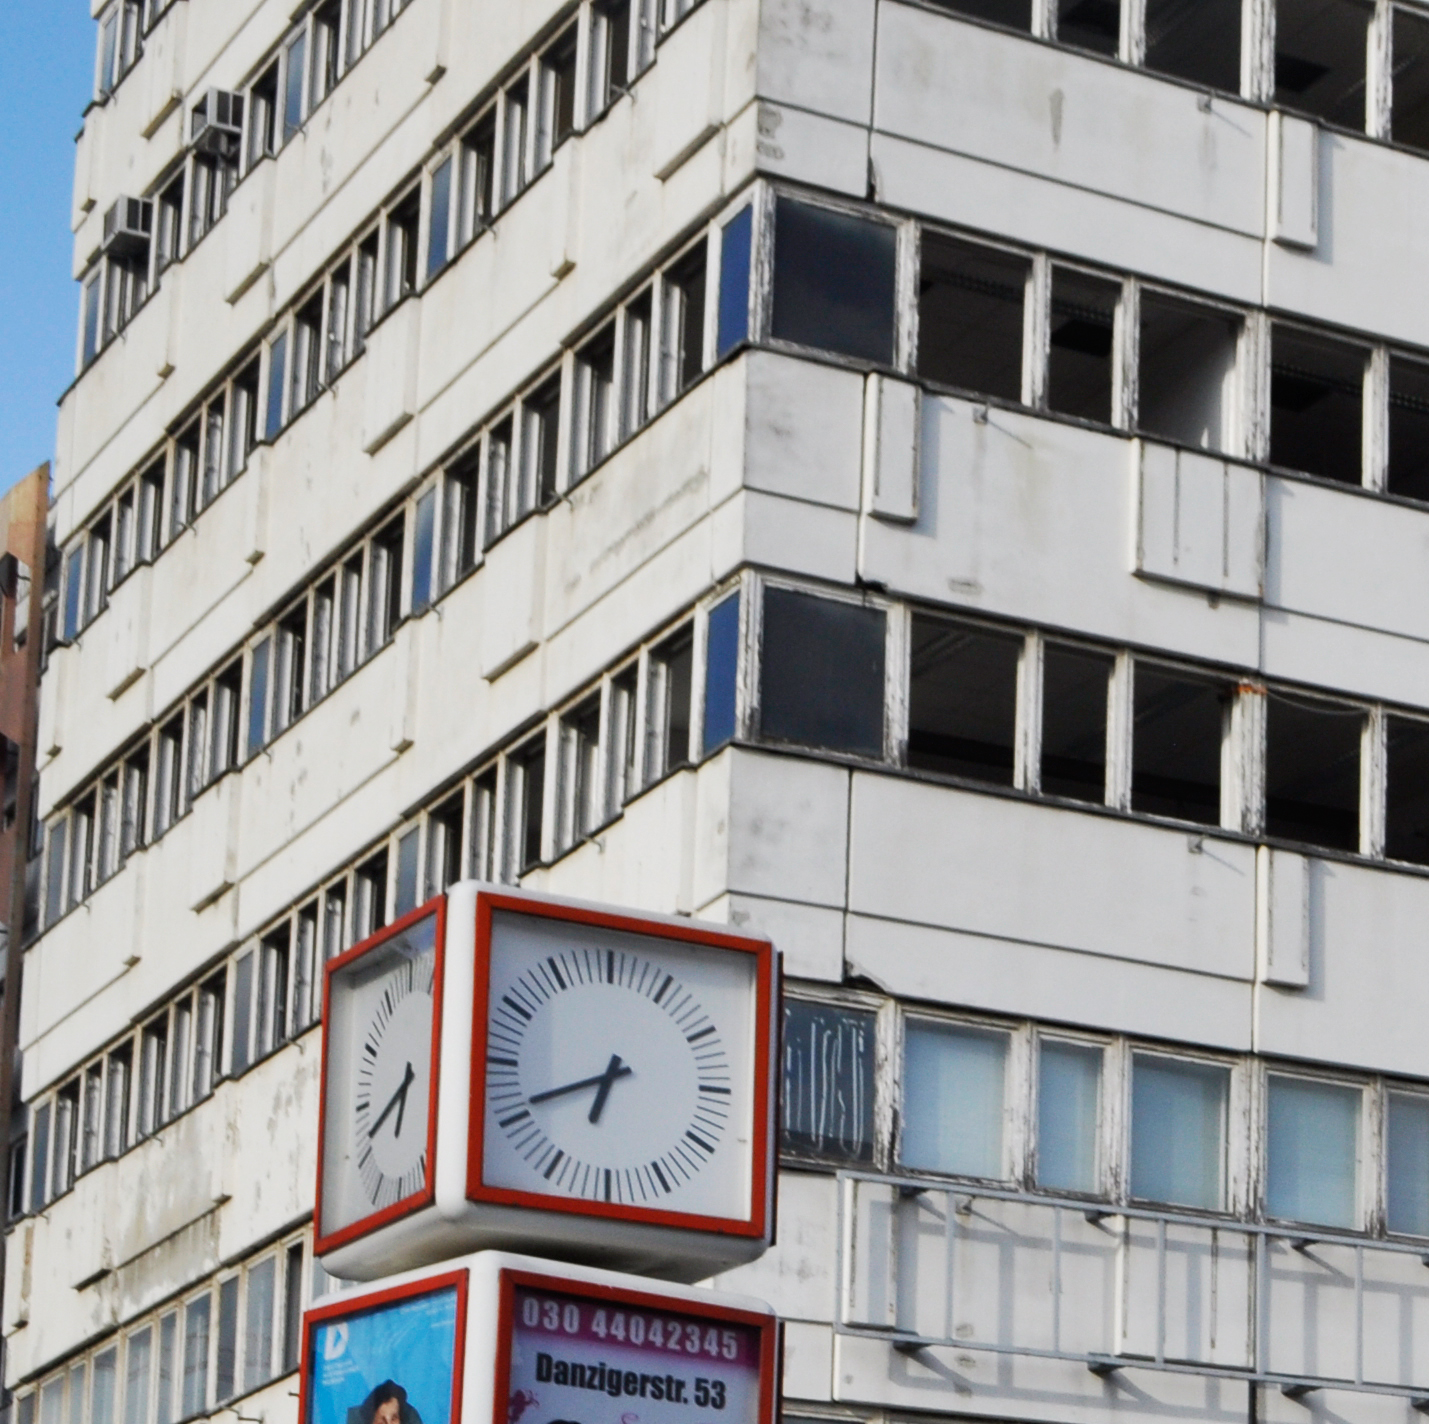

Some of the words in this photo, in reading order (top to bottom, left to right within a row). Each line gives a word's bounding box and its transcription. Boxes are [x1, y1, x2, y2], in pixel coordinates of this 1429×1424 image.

[522, 1298, 580, 1334] 030
[591, 1309, 739, 1361] 44042345
[535, 1351, 689, 1405] Danzigerstr.
[693, 1376, 726, 1410] 53
